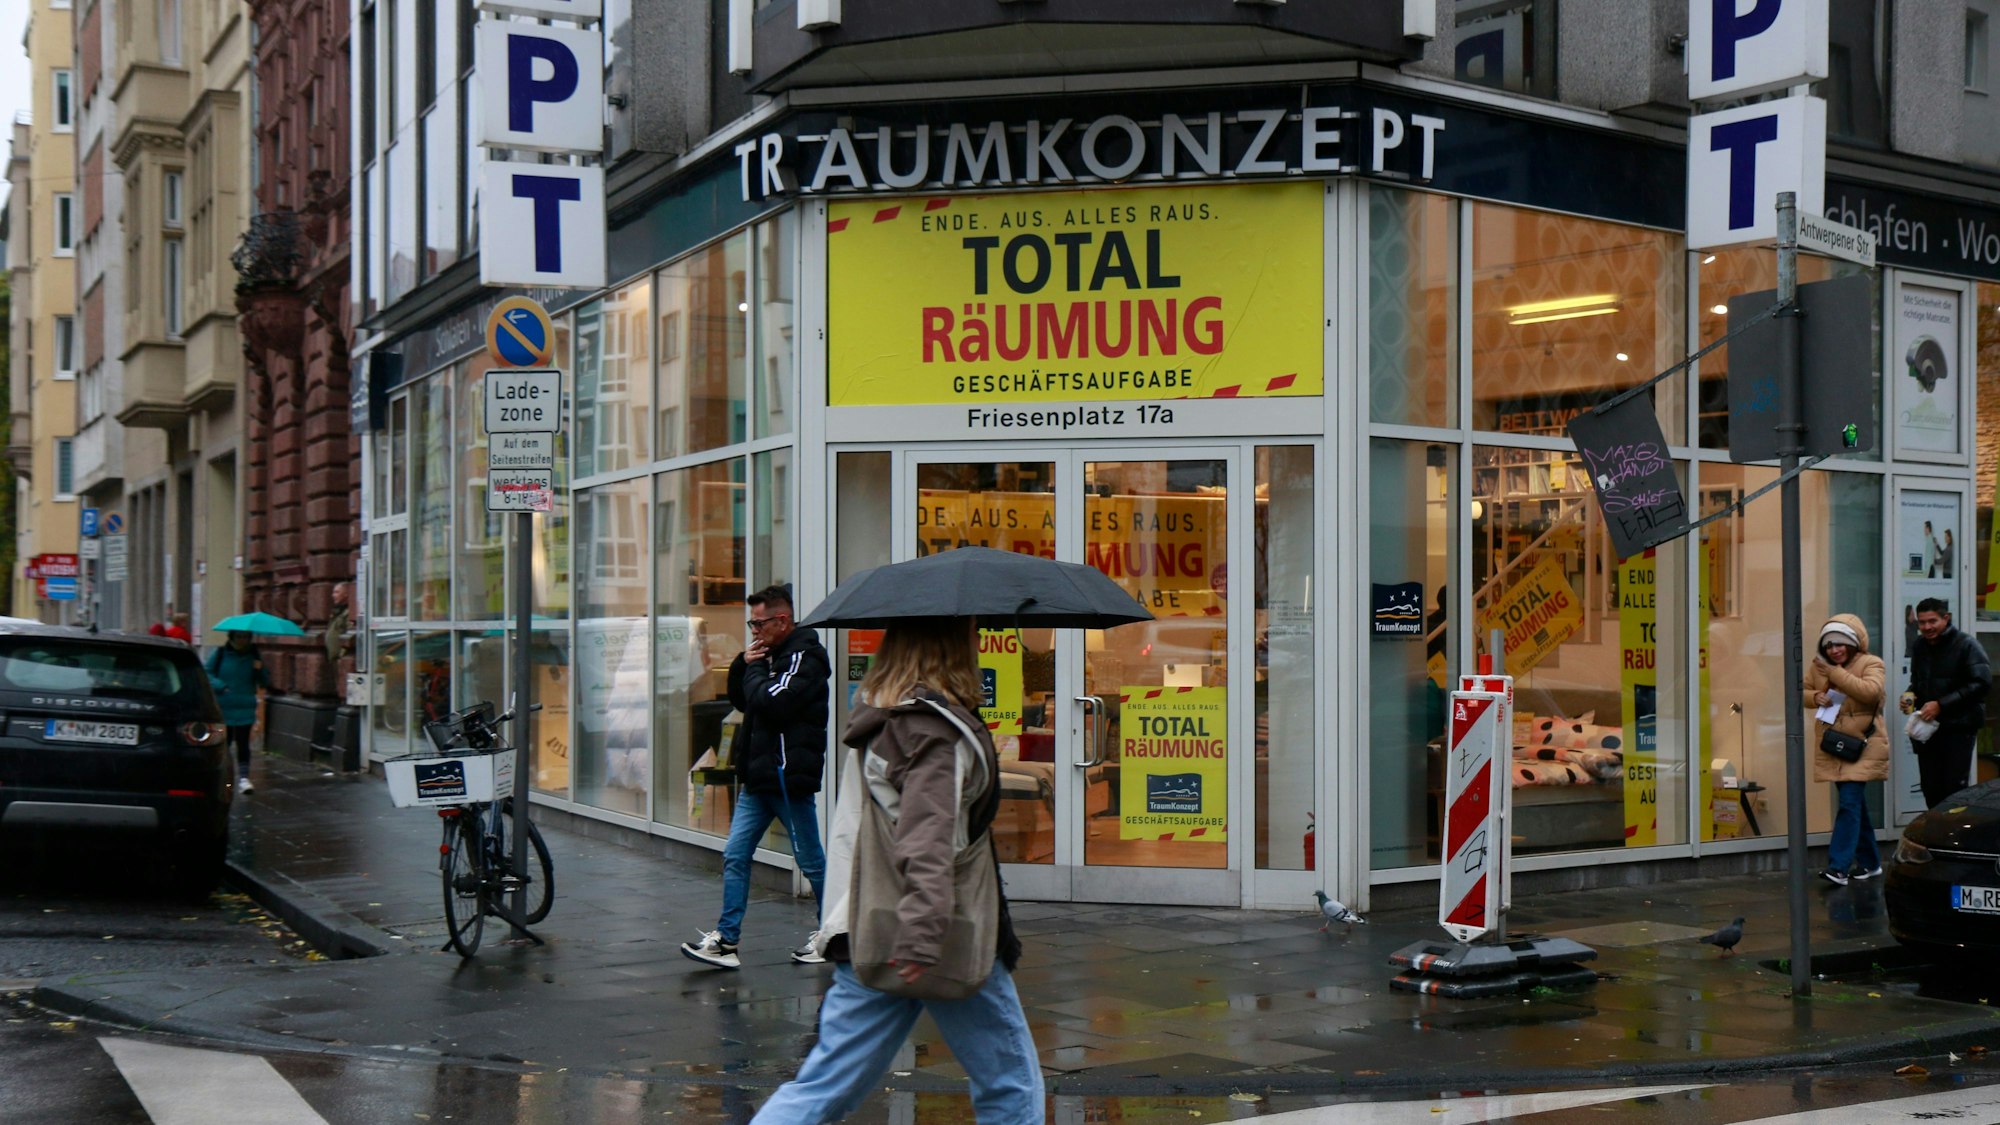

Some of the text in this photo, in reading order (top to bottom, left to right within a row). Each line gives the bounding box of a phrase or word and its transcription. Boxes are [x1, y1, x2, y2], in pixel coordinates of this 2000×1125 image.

[507, 0, 581, 273] PT
[921, 203, 1220, 232] ENDE. AUS. ALLES RAUS.
[1825, 195, 1928, 254] chlafen
[1799, 216, 1872, 257] Antwerpener Str.
[962, 228, 1181, 295] TOTAL
[922, 295, 1224, 363] RäUMUNG
[495, 381, 550, 400] Lade-
[953, 369, 1193, 393] GESCHÄFTSAUFGABE
[500, 407, 543, 421] zone
[968, 405, 1174, 430] Friesenplatz 17a
[503, 438, 539, 449] Auf dem
[492, 454, 551, 465] Seitenstreifen
[1629, 569, 1655, 585] END
[1499, 583, 1550, 630] TOTAL
[1623, 593, 1656, 609] ALLE
[1375, 621, 1421, 634] TraumKonzept
[31, 696, 156, 711] DISCOVERY
[1138, 716, 1210, 737] TOTAL
[1125, 738, 1224, 759] RäUMUNG
[419, 787, 465, 796] TraumKonzept
[1150, 801, 1199, 812] TraumKonzept
[1125, 815, 1224, 826] GESCHÄFTSAUFGABE
[1962, 888, 1972, 906] M
